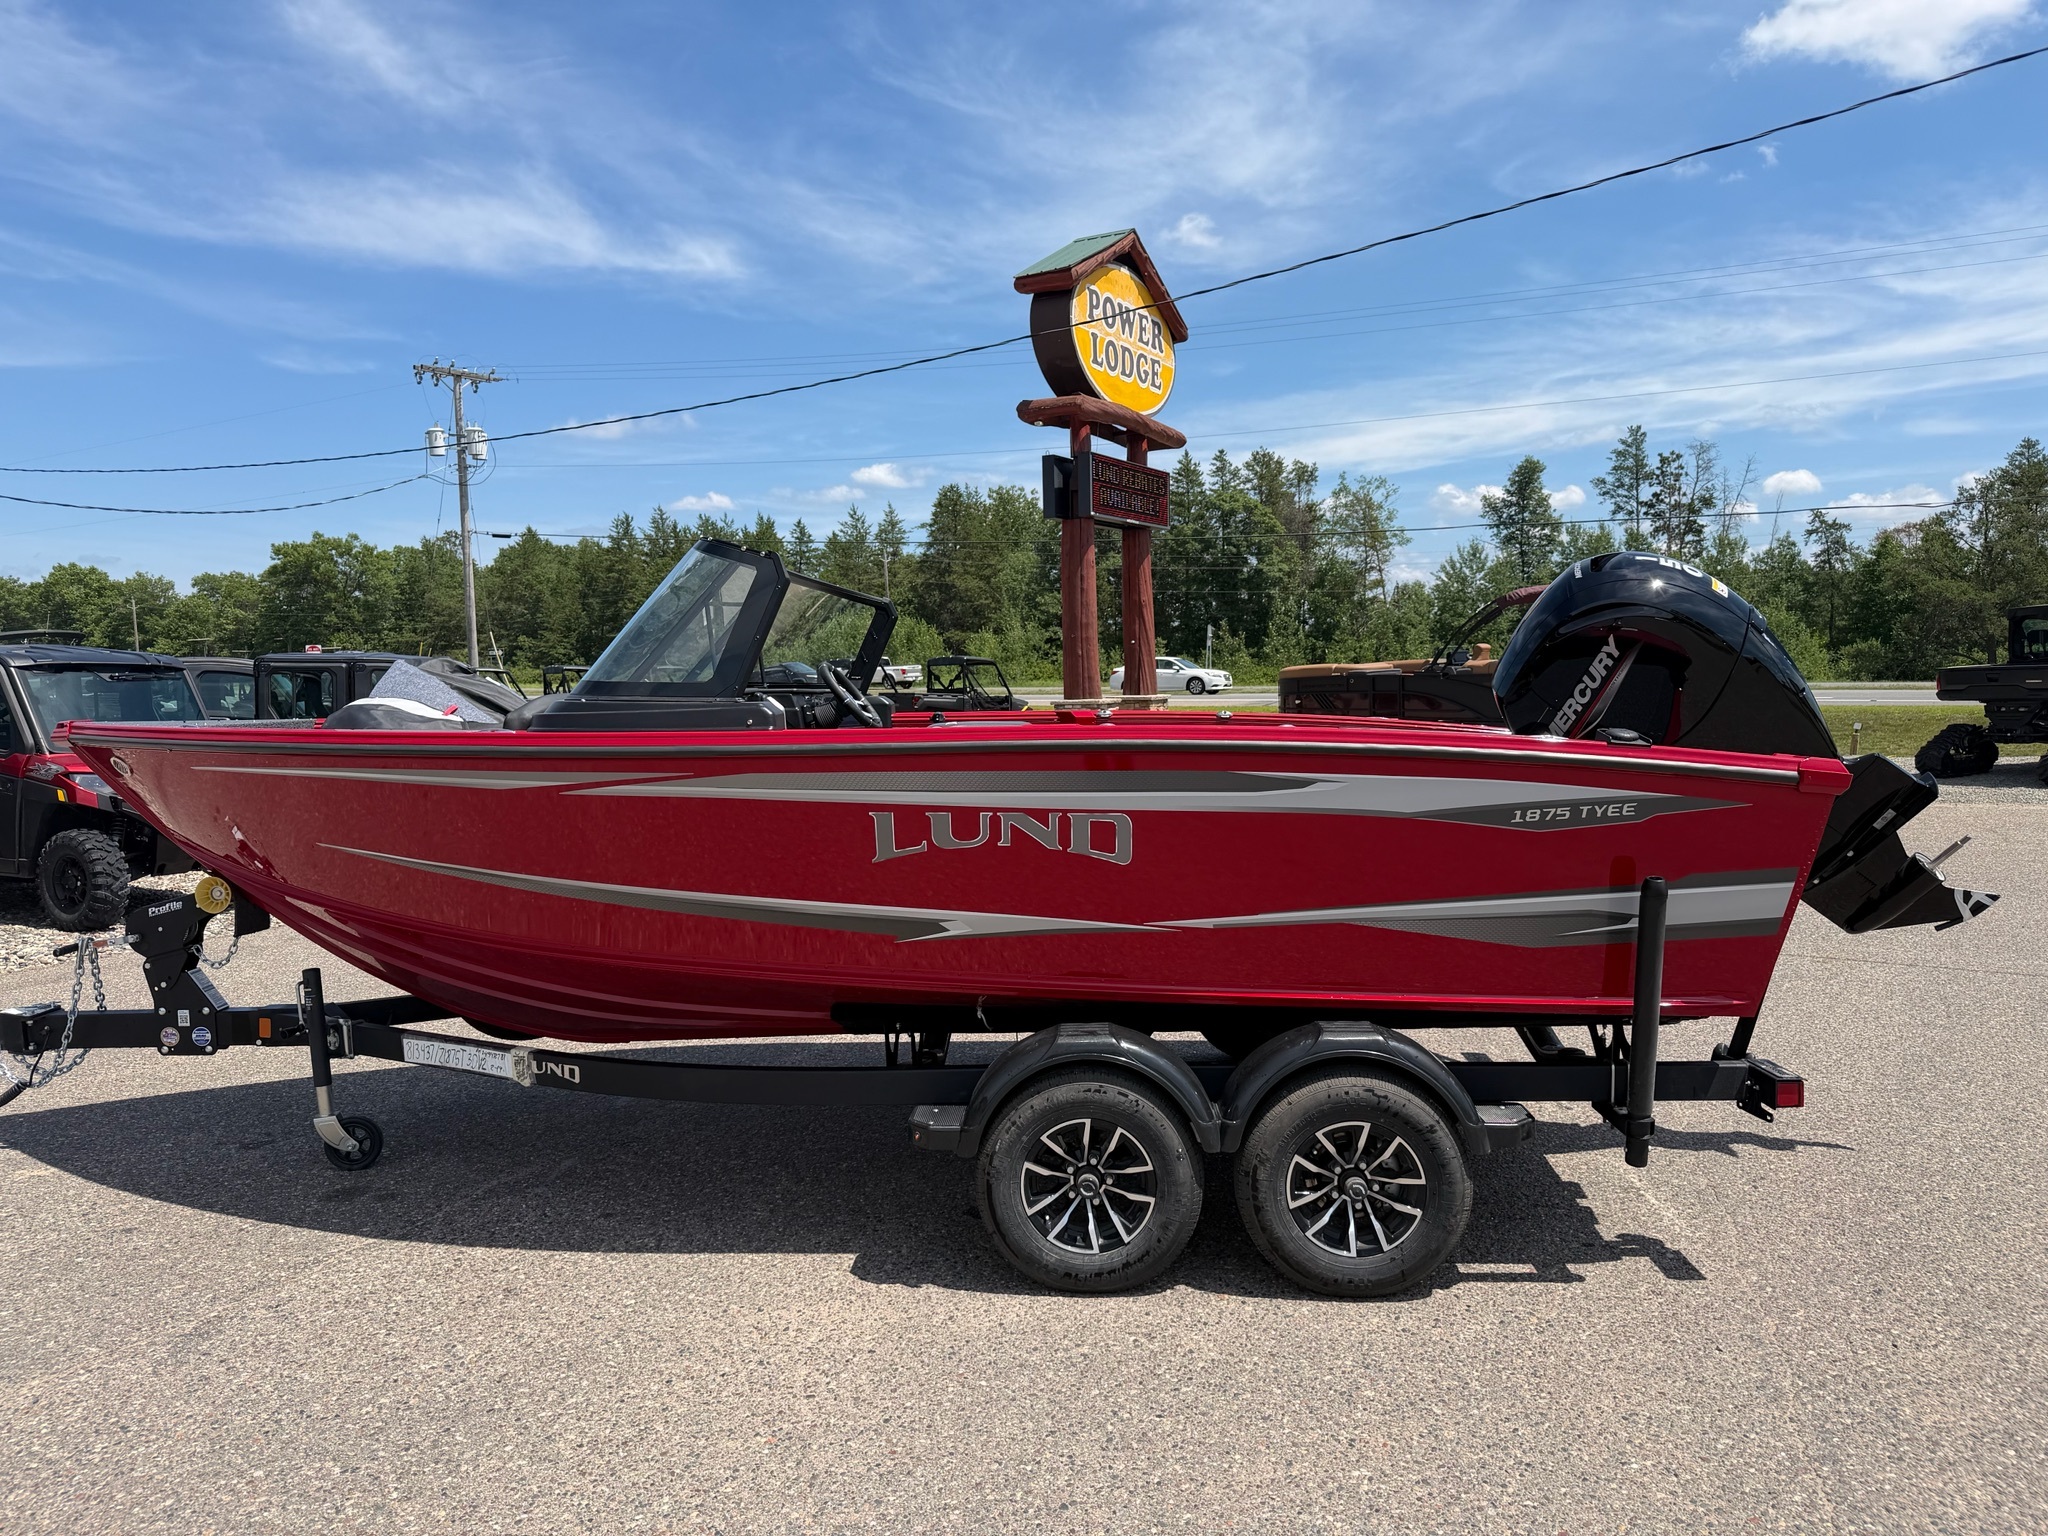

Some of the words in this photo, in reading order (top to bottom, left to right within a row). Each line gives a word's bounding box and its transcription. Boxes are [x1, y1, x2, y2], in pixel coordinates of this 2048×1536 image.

[1086, 285, 1164, 354] POWER
[1090, 332, 1162, 391] LODGE
[1122, 469, 1165, 495] REBATES
[1510, 807, 1571, 823] 1875
[1579, 802, 1638, 818] TYEE
[868, 811, 1133, 865] LUND
[148, 901, 183, 915] Profile
[530, 1060, 581, 1084] UND
